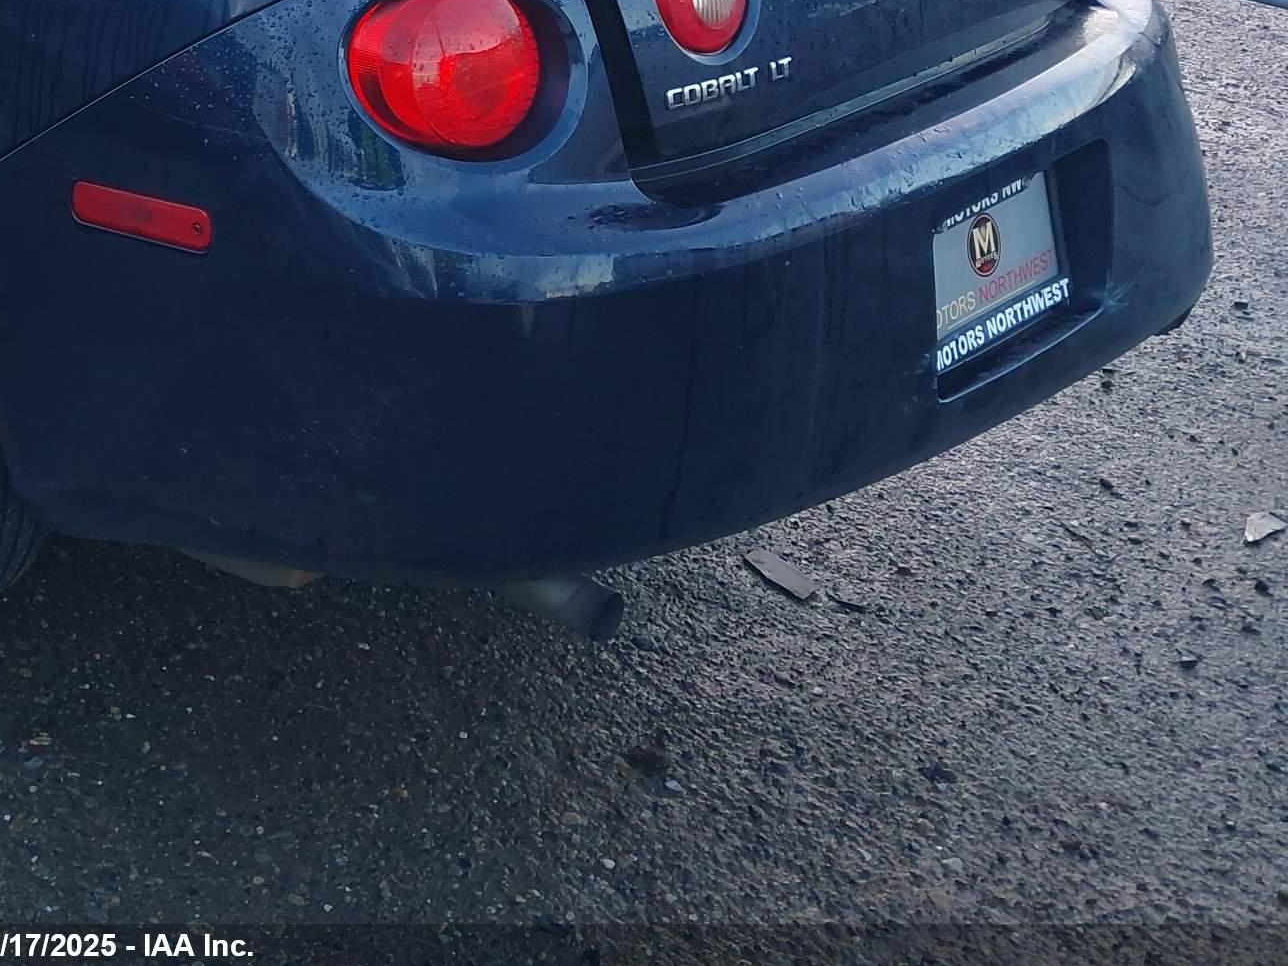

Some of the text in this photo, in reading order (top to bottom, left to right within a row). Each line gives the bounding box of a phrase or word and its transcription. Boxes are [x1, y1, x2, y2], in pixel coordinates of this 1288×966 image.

[665, 56, 793, 110] COBALT LT
[936, 249, 1055, 330] OTORS NORTHWEST
[985, 277, 1070, 339] NORTHWEST
